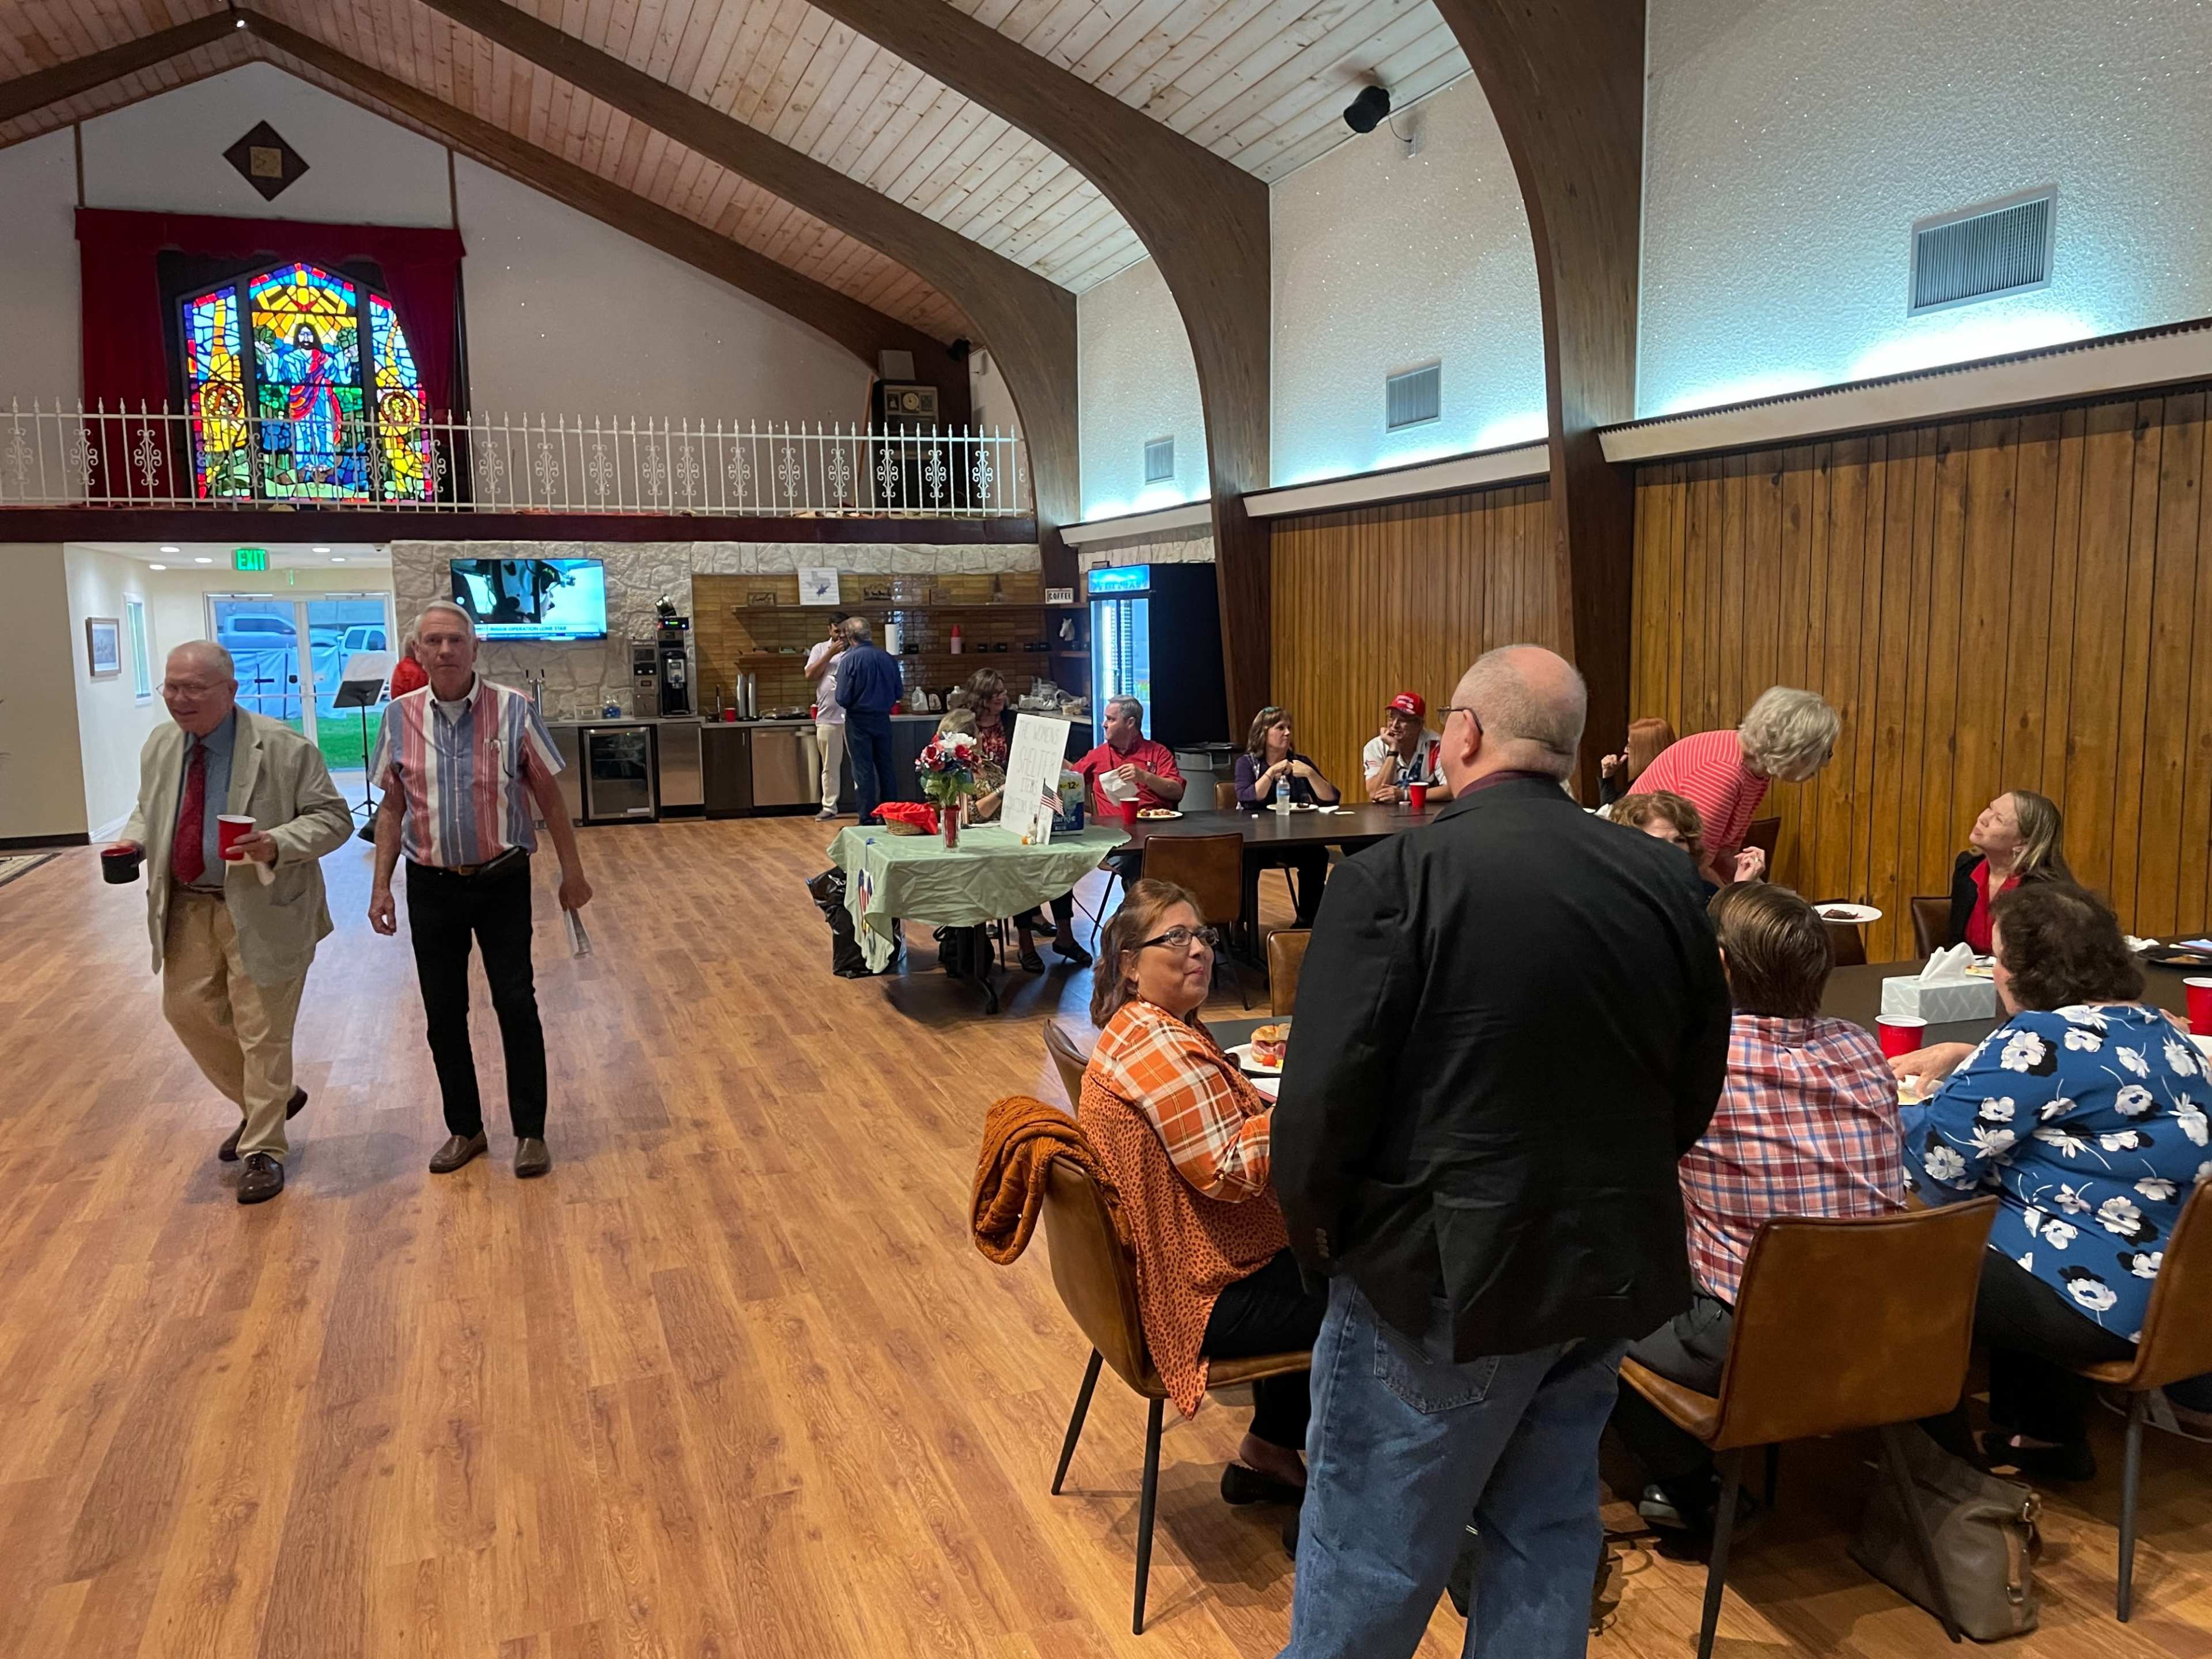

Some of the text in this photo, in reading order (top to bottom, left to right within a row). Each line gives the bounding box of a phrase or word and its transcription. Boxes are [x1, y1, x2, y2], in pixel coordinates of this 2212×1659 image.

[237, 550, 266, 570] EXIT
[1017, 745, 1058, 778] SHELTER
[1067, 781, 1076, 789] 12
[1053, 813, 1077, 823] arkle
